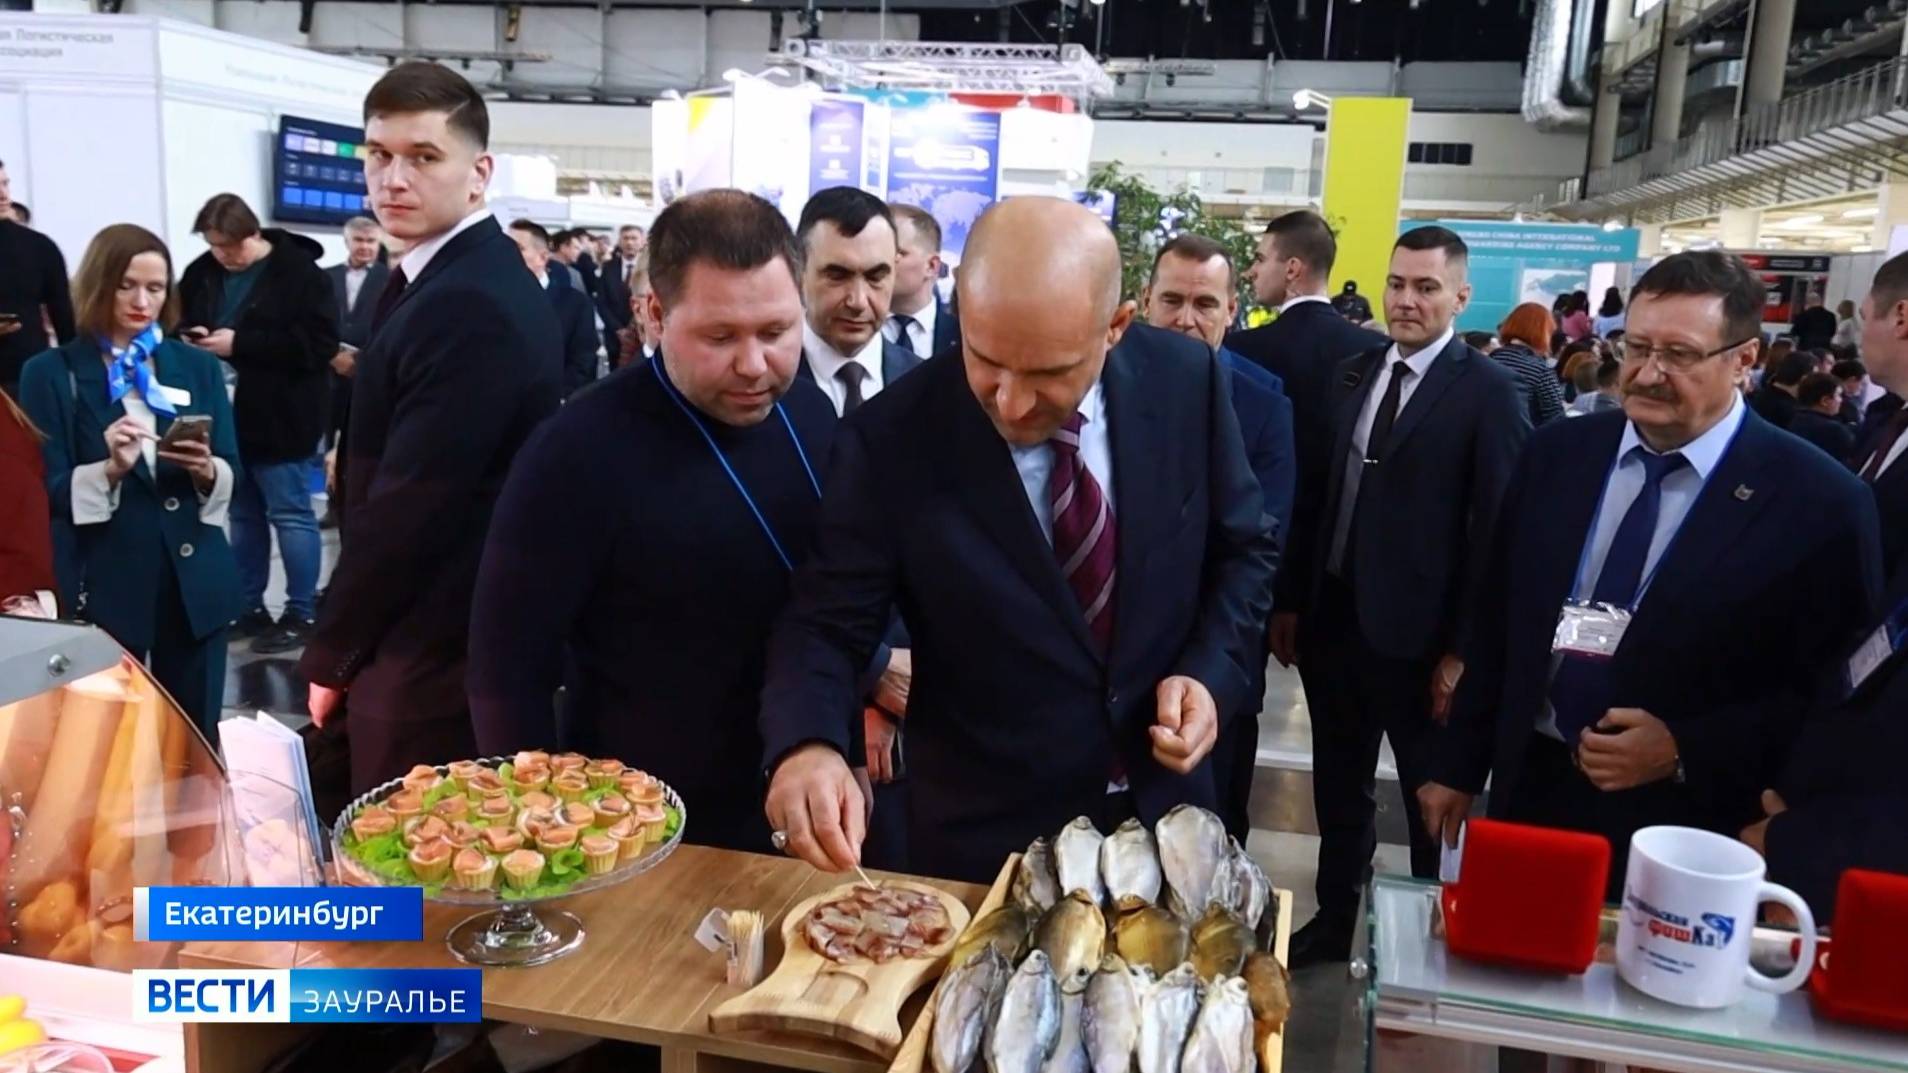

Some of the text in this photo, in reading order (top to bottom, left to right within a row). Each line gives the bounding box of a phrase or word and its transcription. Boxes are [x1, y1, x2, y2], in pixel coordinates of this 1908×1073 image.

[1492, 231, 1521, 240] CHINA
[1522, 231, 1596, 242] INTERNATIONAL
[1515, 240, 1554, 251] AGENCY
[1555, 242, 1601, 252] COMPANY
